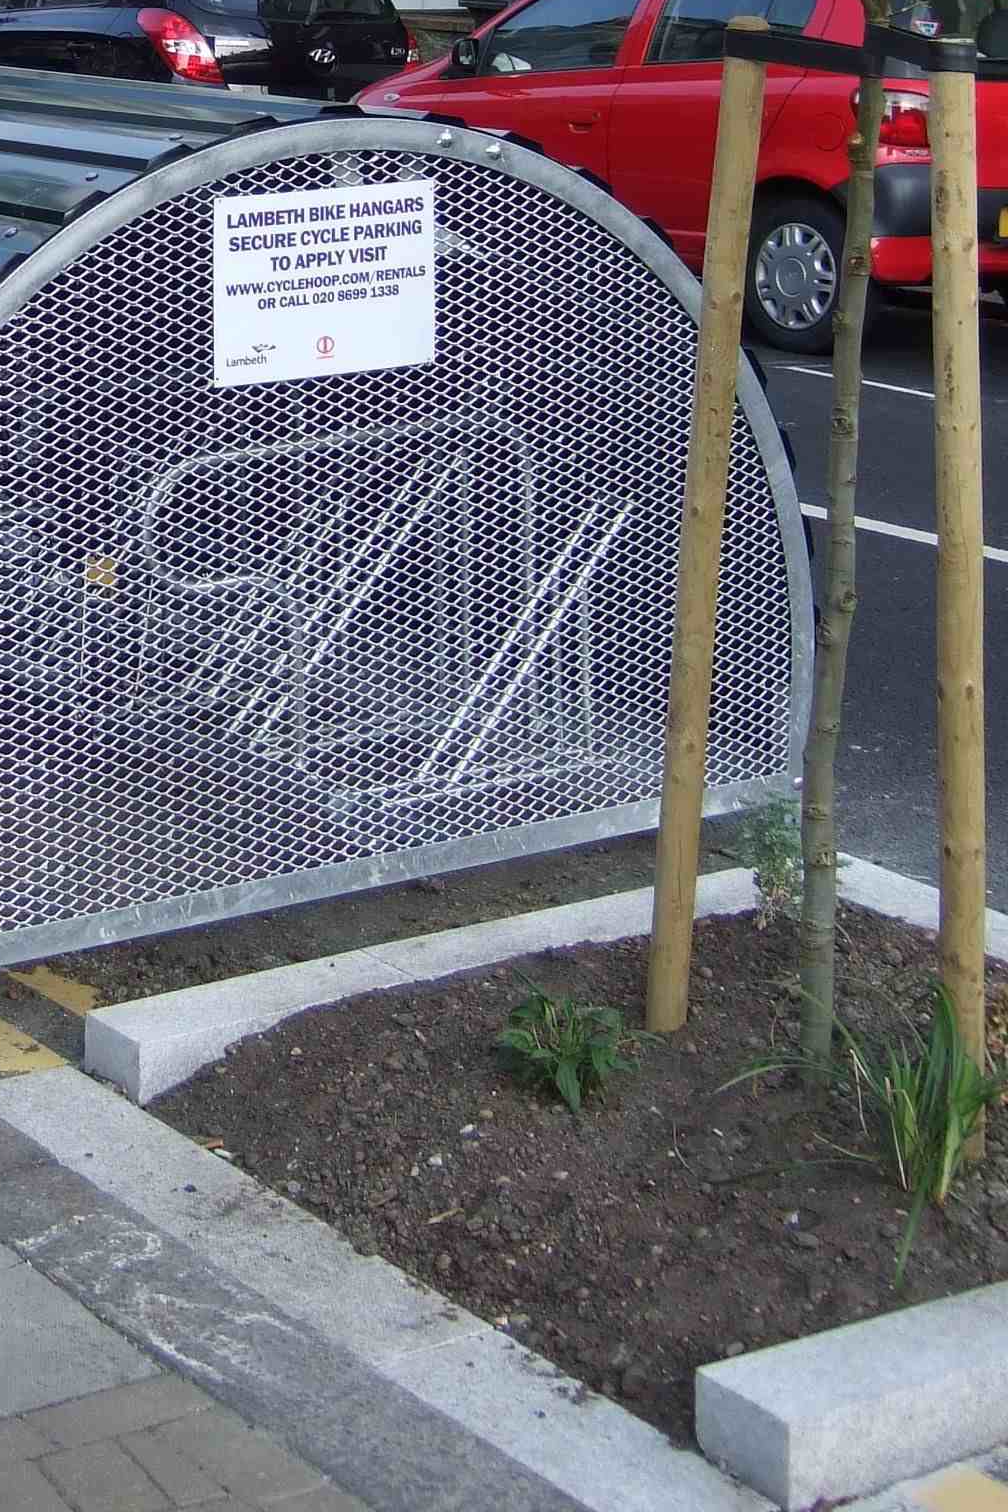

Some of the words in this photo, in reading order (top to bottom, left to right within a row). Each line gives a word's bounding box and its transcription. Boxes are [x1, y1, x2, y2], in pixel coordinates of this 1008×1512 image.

[227, 207, 305, 229] LAMBETH
[309, 203, 346, 222] BIKE
[349, 196, 424, 218] HANGARS
[229, 232, 297, 252] SECURE
[300, 227, 350, 246] CYCLE
[353, 219, 422, 241] PARKING
[270, 255, 291, 272] TO
[295, 249, 345, 270] APPLY
[348, 246, 387, 263] VISIT
[226, 265, 426, 296] WWW.CYCLEHOOP.COM/RENTALS
[257, 297, 276, 310] OR
[279, 294, 310, 308] CALL
[312, 291, 335, 304] 020
[337, 287, 367, 301] 8699
[370, 284, 399, 298] 1338
[225, 354, 268, 367] Lambeth
